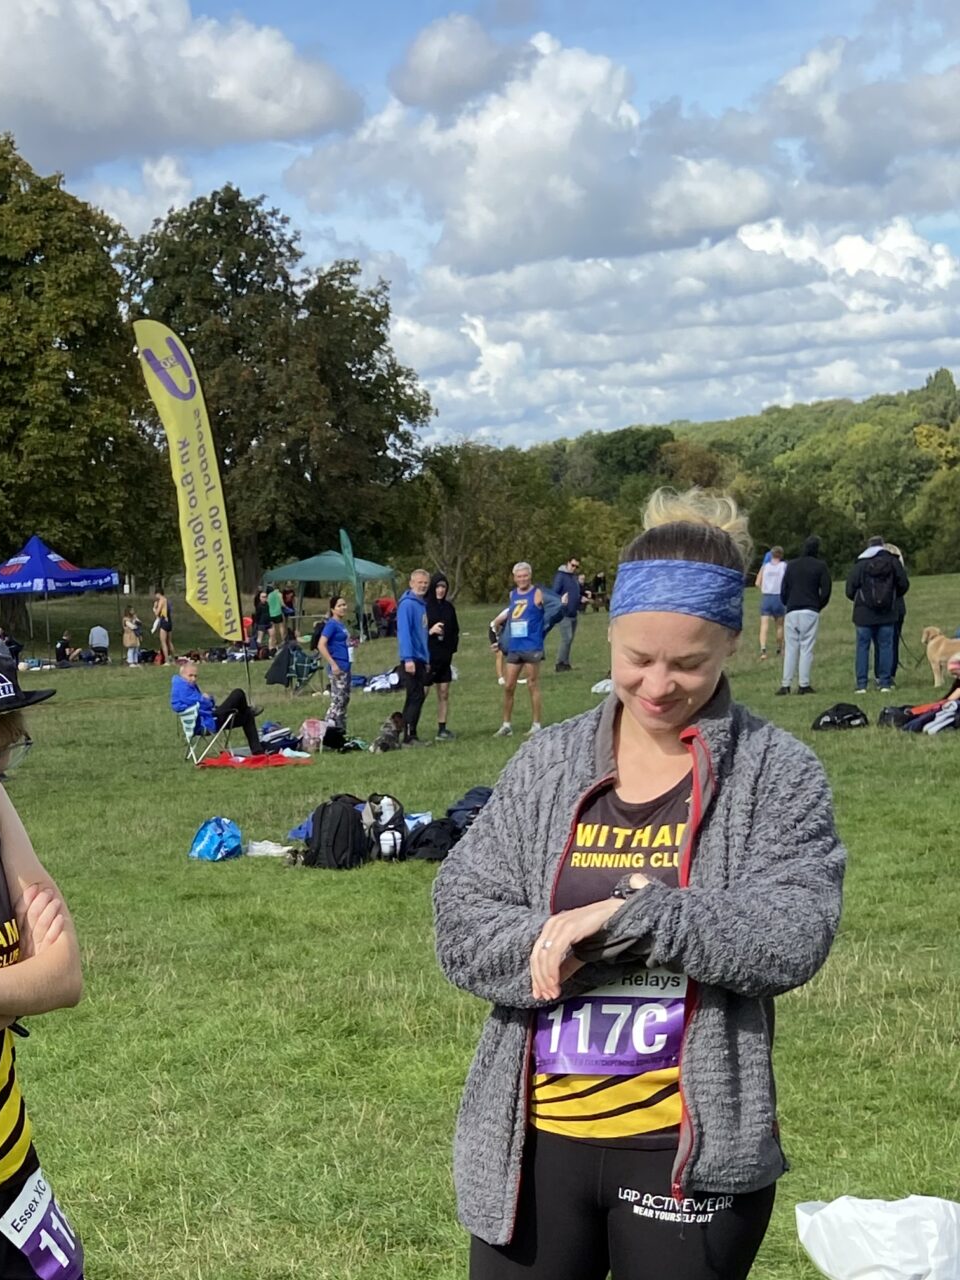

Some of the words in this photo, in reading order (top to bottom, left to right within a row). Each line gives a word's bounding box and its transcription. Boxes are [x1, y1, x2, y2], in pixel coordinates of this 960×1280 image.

[570, 852, 644, 868] RUNNING
[621, 971, 681, 991] Relays
[547, 1001, 668, 1057] 117C
[11, 1197, 40, 1233] Essex
[33, 1179, 47, 1200] XC
[618, 1187, 641, 1203] LAP
[642, 1194, 734, 1213] ACTIVEWEAR
[633, 1204, 654, 1219] WEAR
[696, 1213, 714, 1223] OUT
